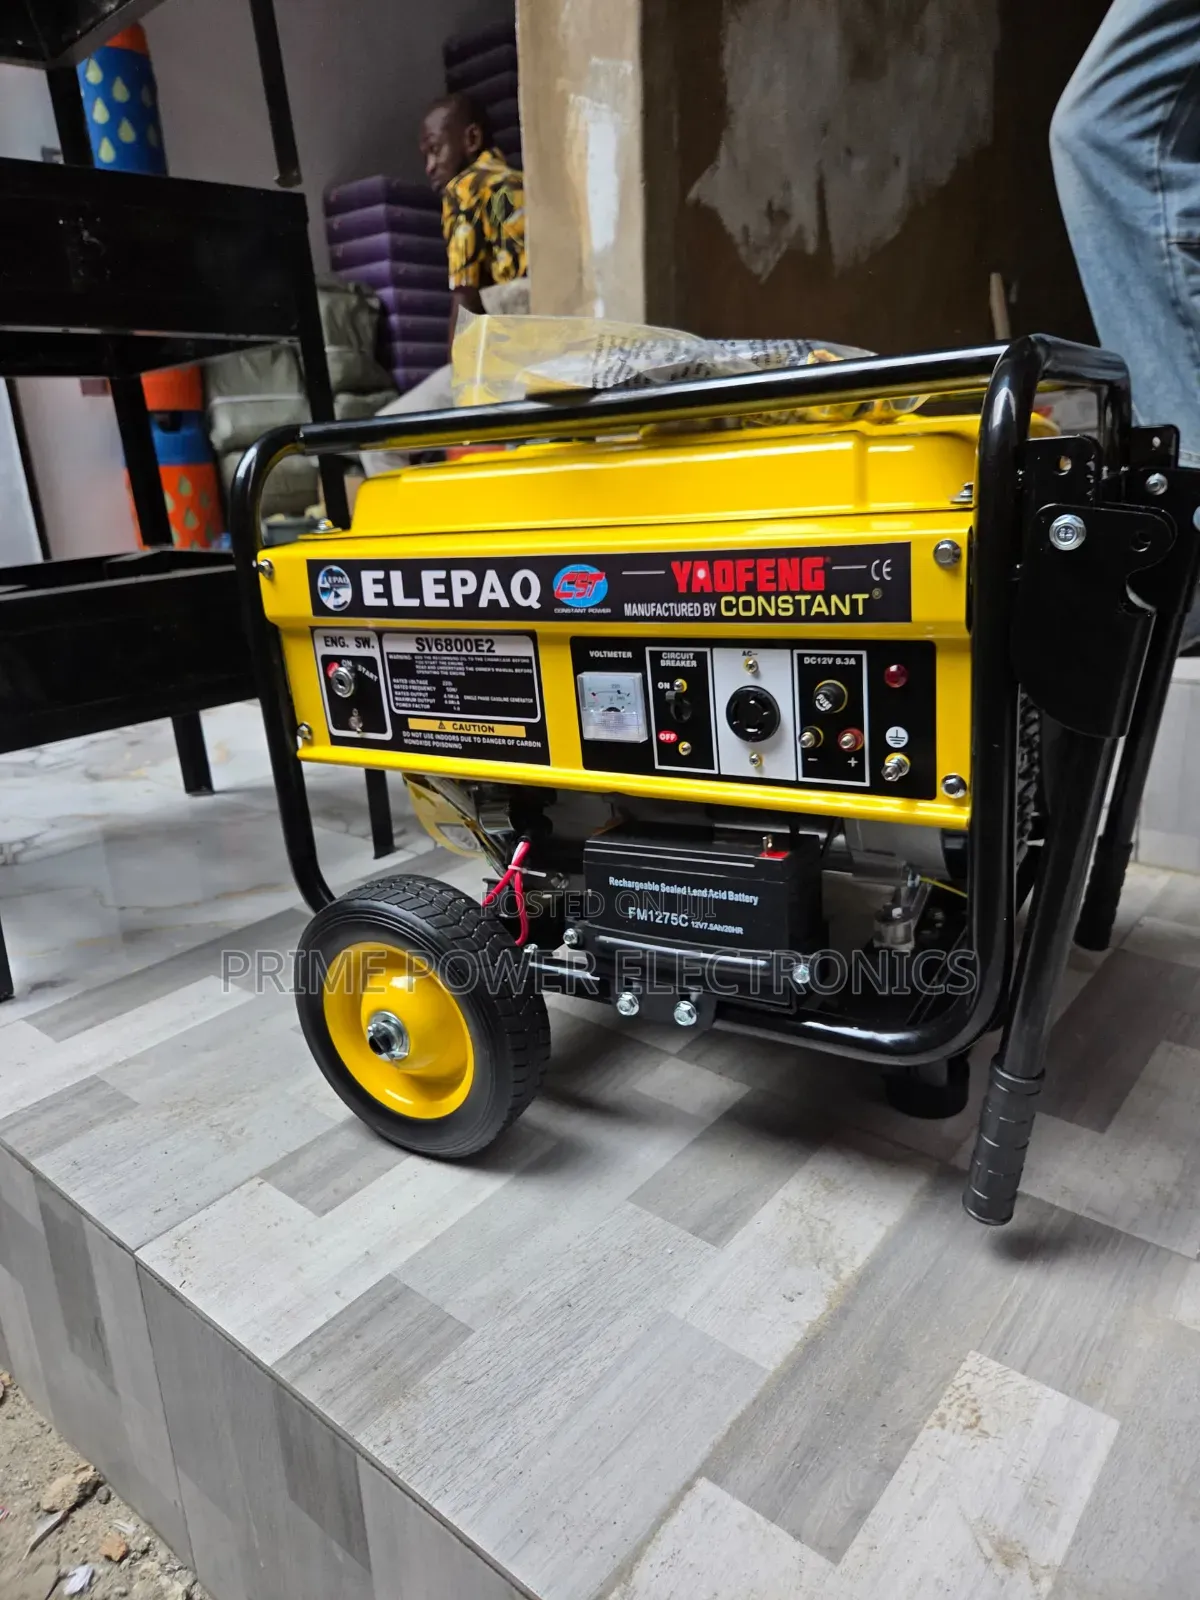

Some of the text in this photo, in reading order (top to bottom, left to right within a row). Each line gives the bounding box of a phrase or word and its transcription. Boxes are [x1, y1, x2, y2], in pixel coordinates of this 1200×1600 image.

[670, 556, 825, 593] YAOFENG
[360, 569, 541, 609] ELEPAQ
[554, 571, 606, 600] CST
[624, 593, 870, 617] MANUFACTURED BY CONSTANT
[323, 636, 375, 649] ENG. SW.
[415, 637, 495, 653] SV6800E2
[589, 650, 633, 658] VOLTMETER
[662, 652, 694, 660] CIRCUIT
[804, 656, 856, 665] DC12V 8.3A
[341, 659, 353, 668] ON
[660, 659, 697, 667] BREAKER
[357, 664, 379, 682] START
[657, 682, 670, 690] ON
[452, 723, 495, 733] CAUTION
[411, 731, 422, 739] NOT
[423, 732, 434, 740] USE
[435, 733, 460, 742] INDOORS
[460, 735, 472, 743] DUE
[482, 737, 506, 745] DANGER
[516, 739, 541, 748] CARBON
[660, 733, 676, 741] OFF
[403, 738, 463, 750] MONOXIDE POISONING
[608, 876, 759, 906] Rechargeable Sealed Lead Acid Battery
[628, 906, 689, 928] FM1275C
